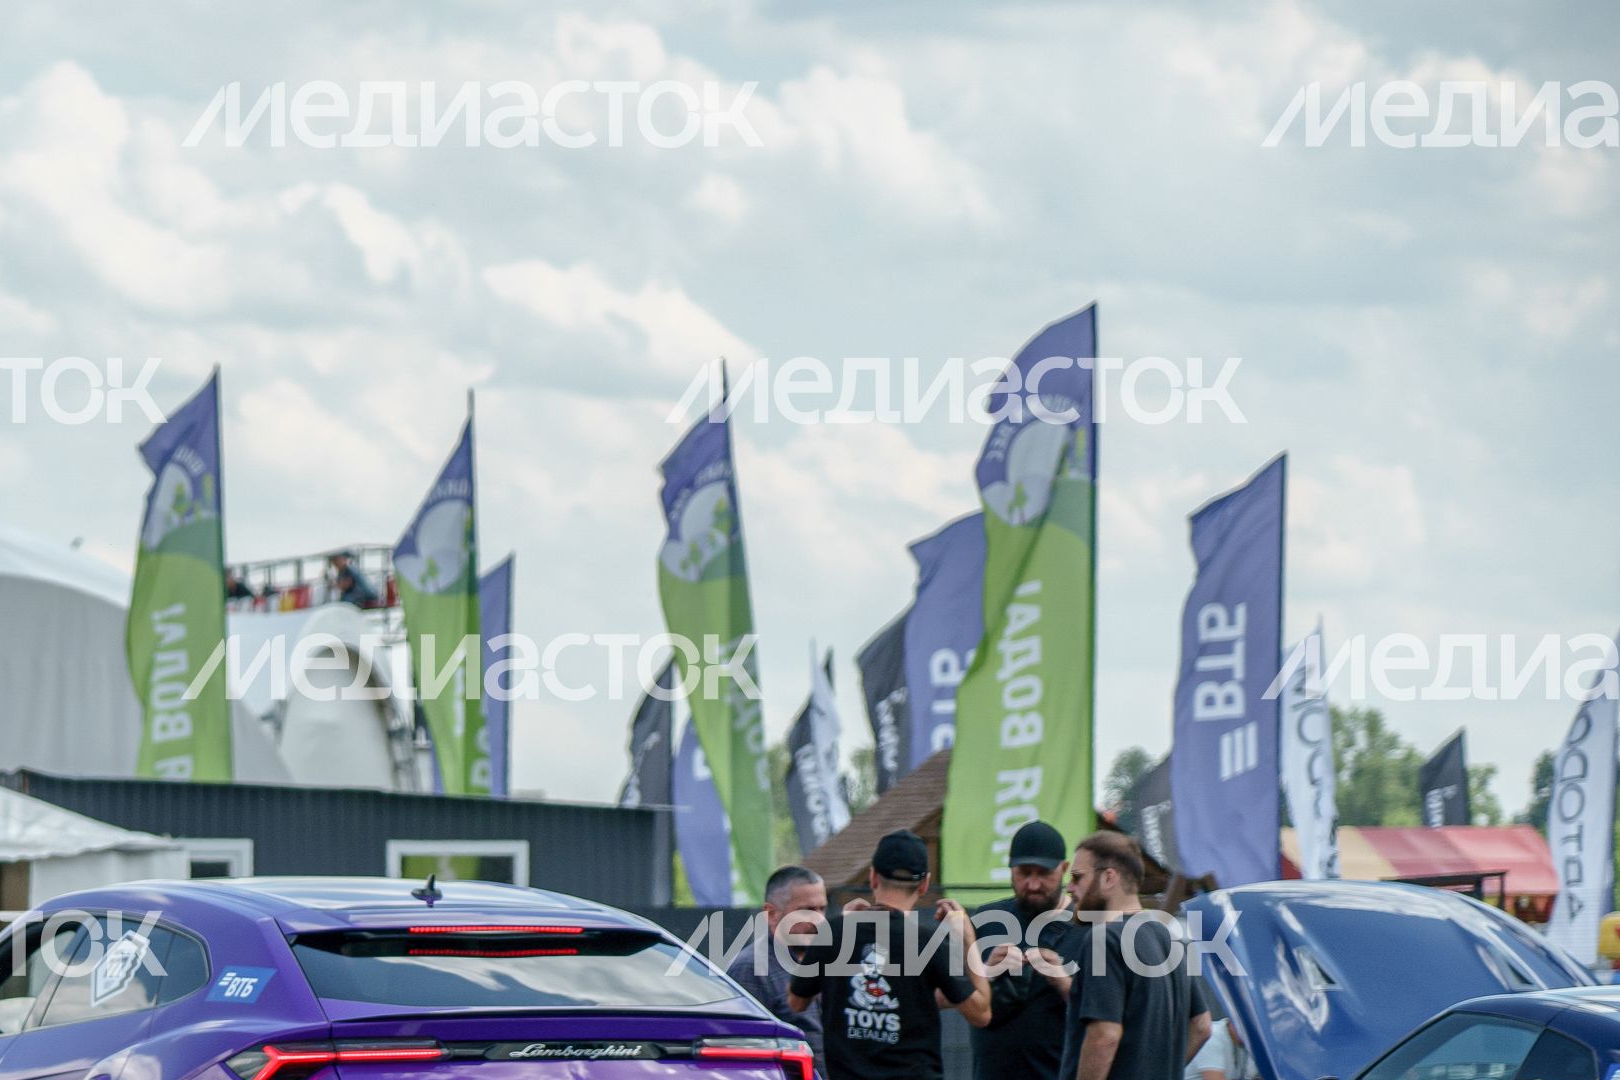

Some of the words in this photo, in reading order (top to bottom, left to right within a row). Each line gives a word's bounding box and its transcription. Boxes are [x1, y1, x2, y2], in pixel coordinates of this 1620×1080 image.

[224, 976, 259, 998] ВТБ
[844, 1008, 901, 1031] TOYS
[847, 1026, 899, 1044] DETAILING
[509, 1043, 642, 1060] Lamborghini
